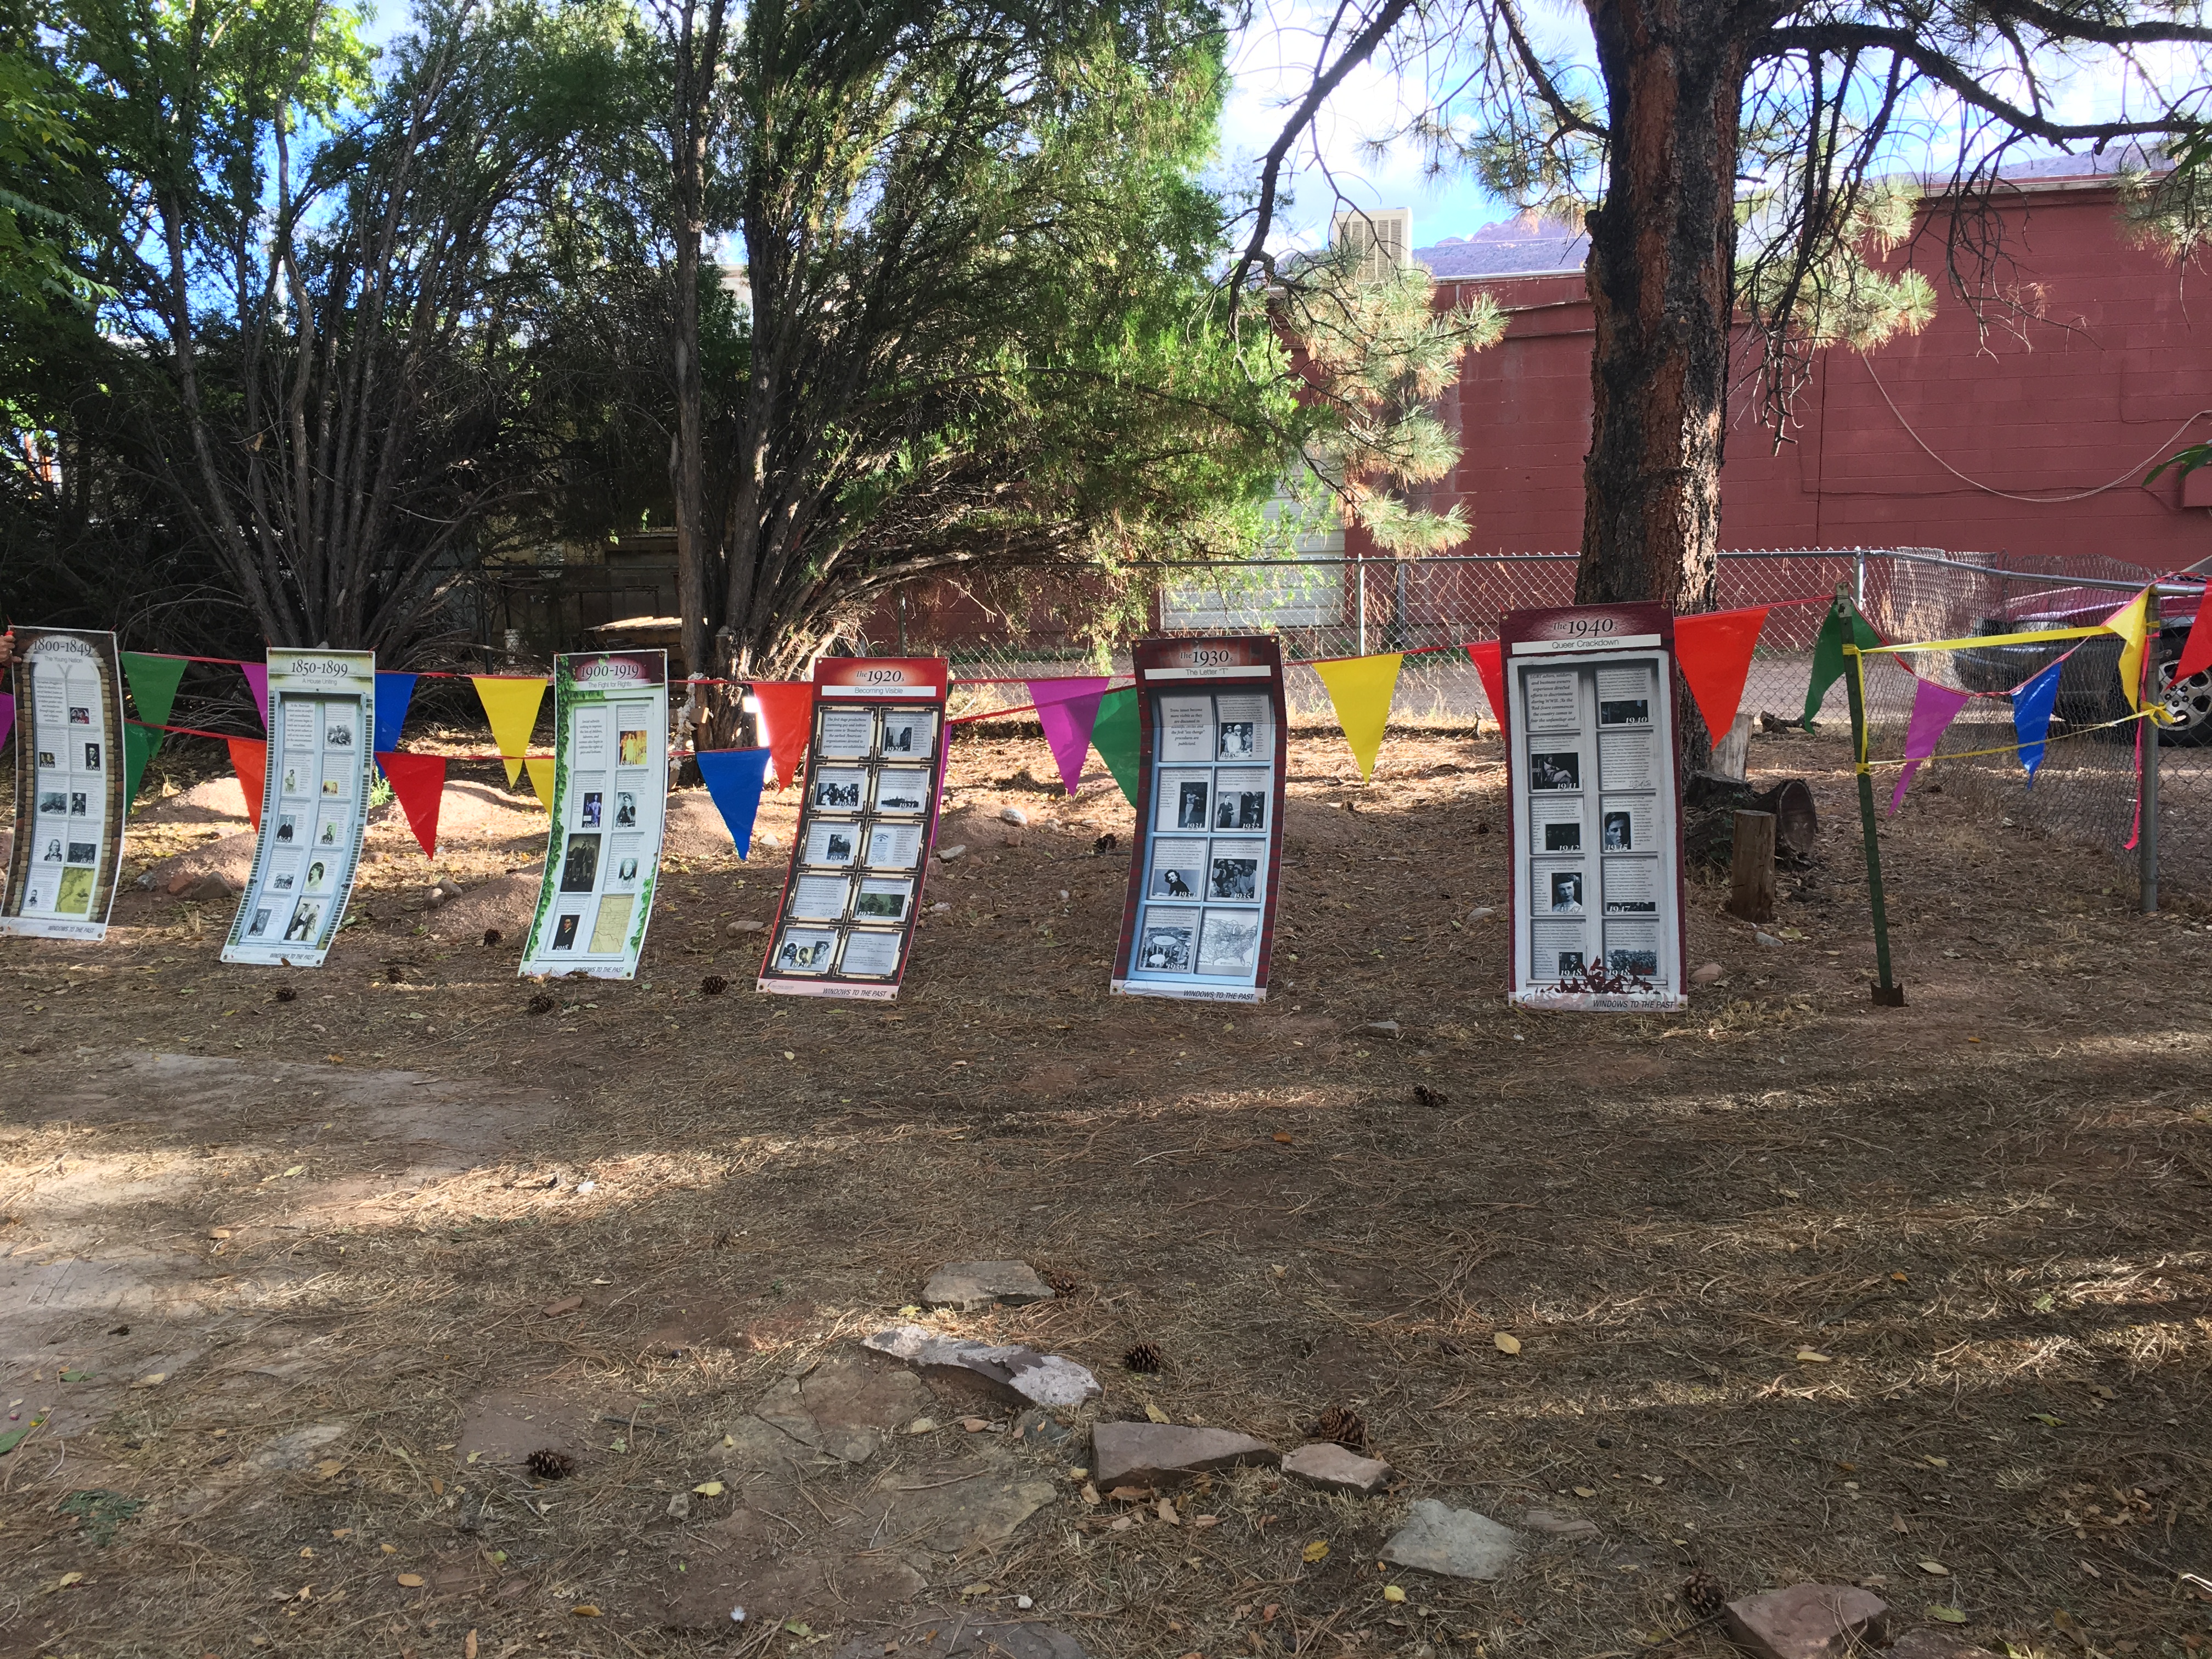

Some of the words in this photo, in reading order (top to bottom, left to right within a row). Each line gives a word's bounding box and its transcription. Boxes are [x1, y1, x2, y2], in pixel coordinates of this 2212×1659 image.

[1553, 622, 1567, 630] The
[33, 637, 91, 656] 1800-1849
[1552, 641, 1575, 649] Queer
[1577, 639, 1619, 648] Crackdown
[291, 659, 348, 677] 1850-1899
[581, 664, 639, 680] 1900-1919
[1629, 780, 1651, 788] 1942
